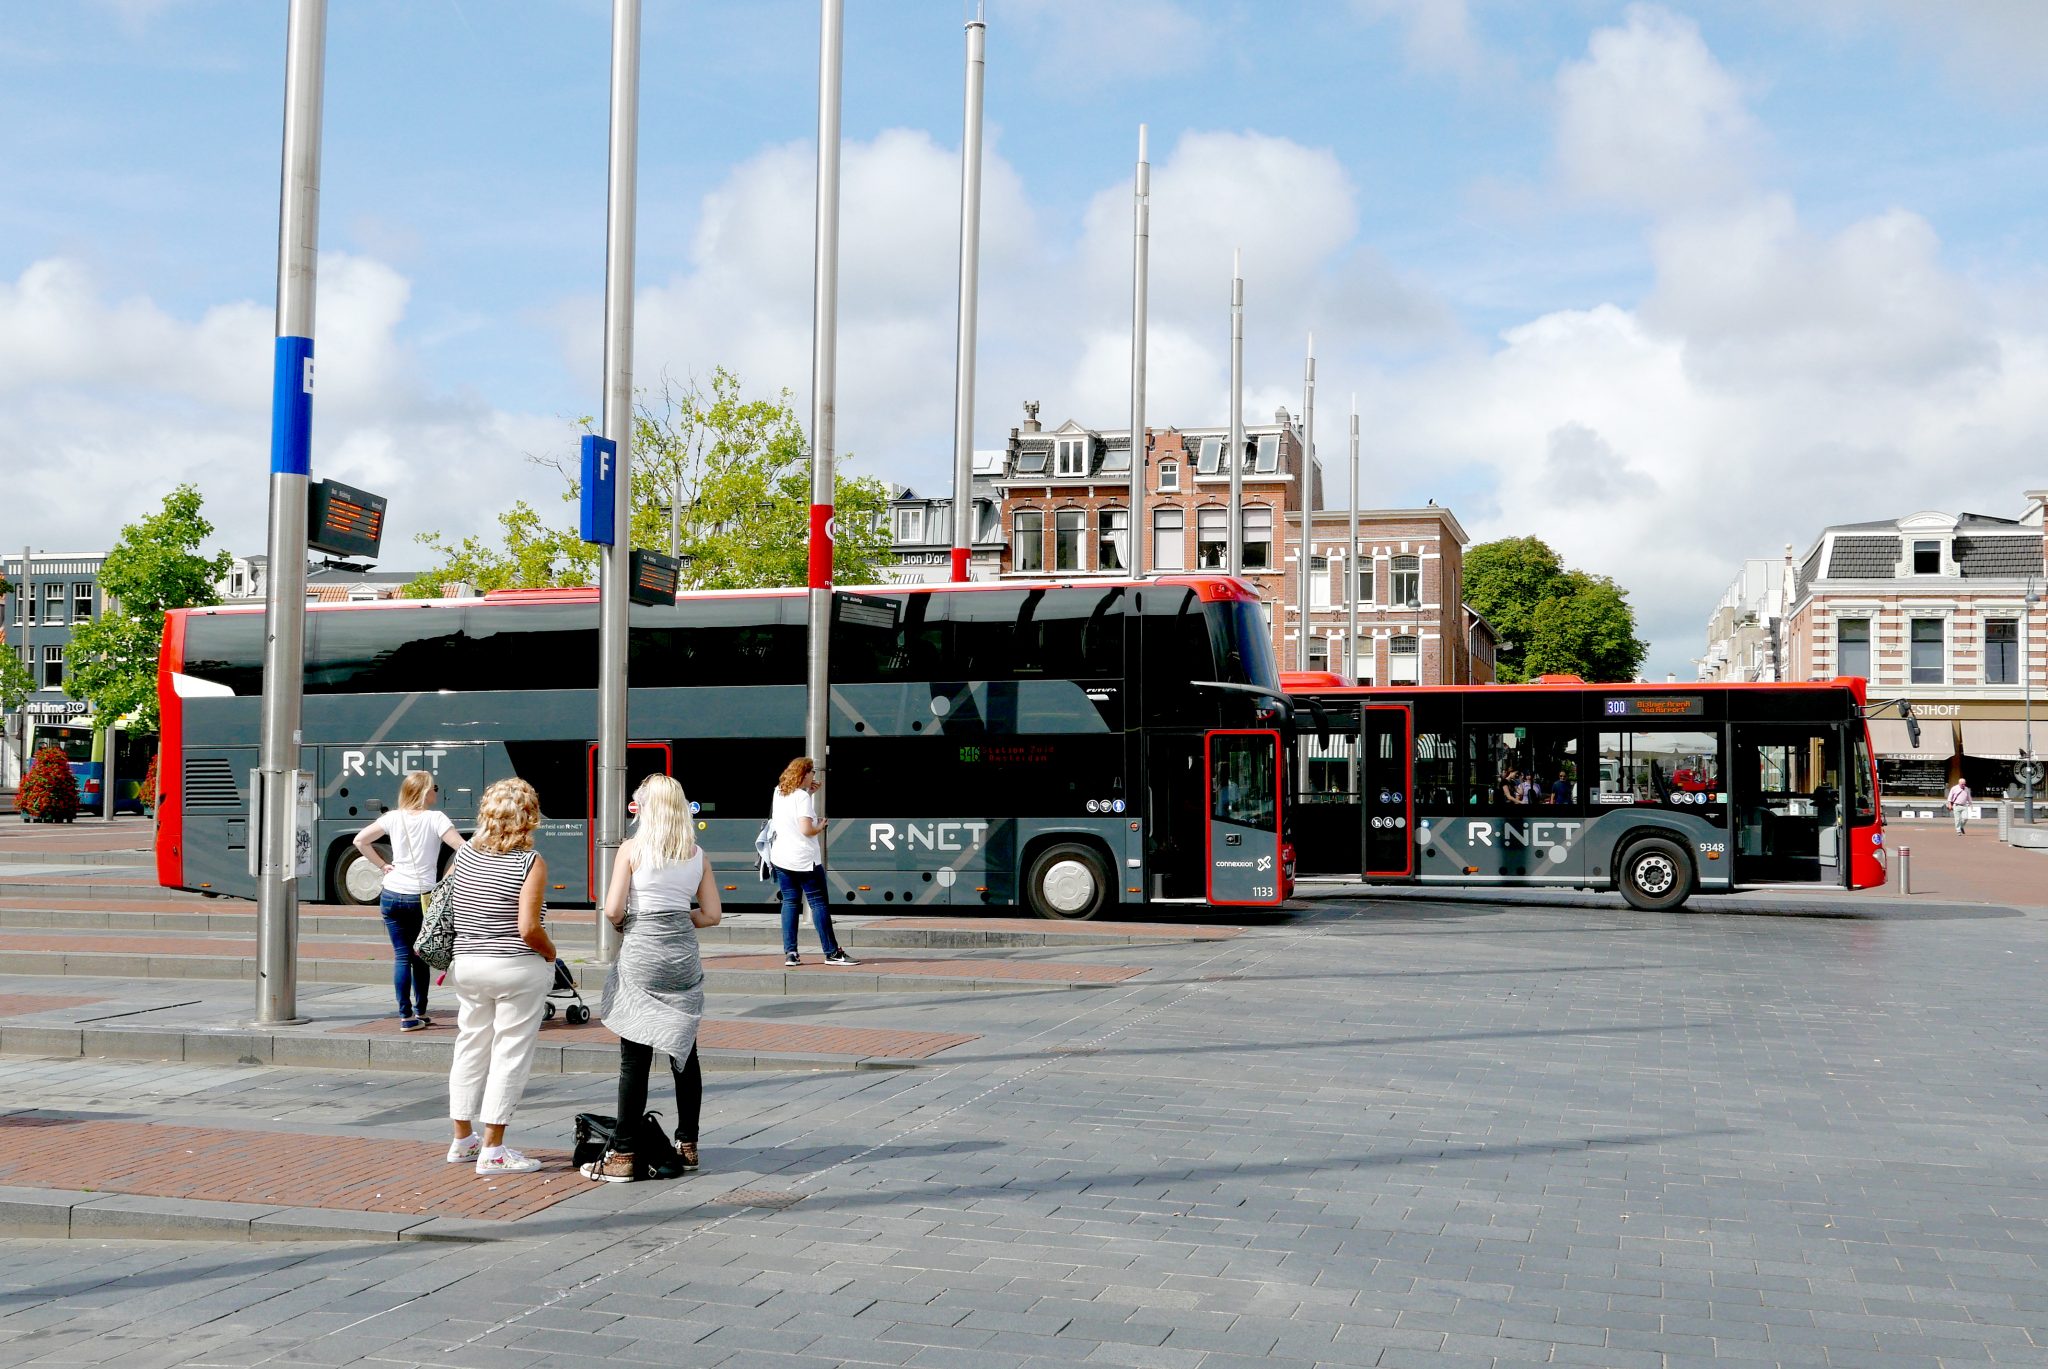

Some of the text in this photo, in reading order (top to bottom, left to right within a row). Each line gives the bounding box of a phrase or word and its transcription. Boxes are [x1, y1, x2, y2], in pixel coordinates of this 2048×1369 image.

[600, 450, 609, 480] F
[902, 553, 944, 564] Lion D'or
[1607, 701, 1625, 713] 300
[1897, 705, 1960, 715] ESTHOFF
[1699, 843, 1725, 852] 9348
[1252, 887, 1274, 896] 1133
